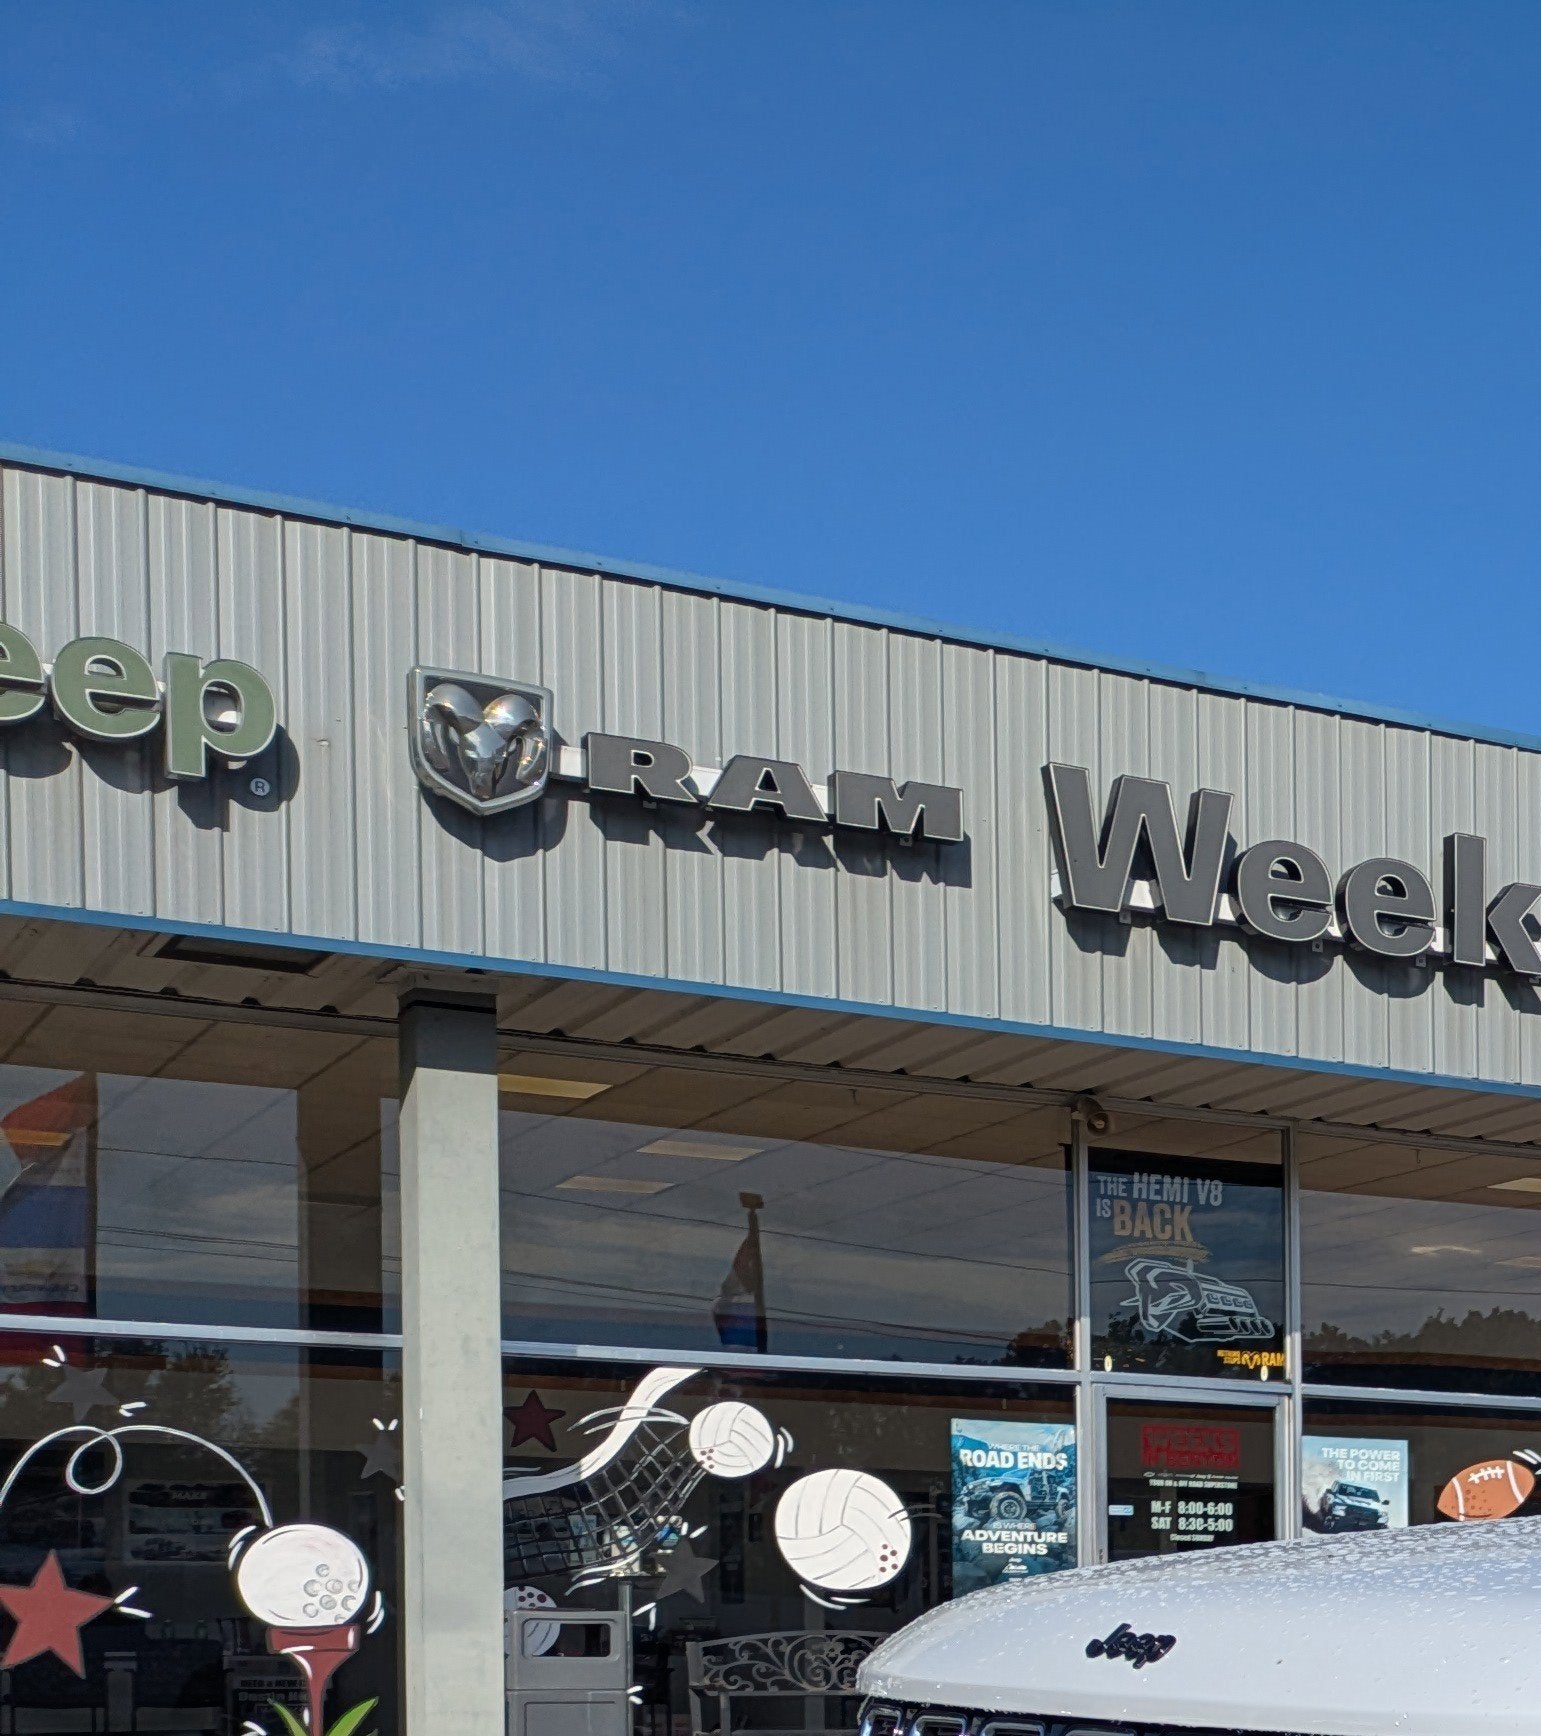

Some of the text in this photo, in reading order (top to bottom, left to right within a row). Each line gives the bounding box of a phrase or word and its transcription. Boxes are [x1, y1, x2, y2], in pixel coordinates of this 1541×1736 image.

[585, 731, 964, 842] RAM
[1094, 1172, 1224, 1207] THE HEMI V8
[1096, 1198, 1194, 1242] IS BACK
[960, 1449, 1068, 1471] ROAD ENDS
[1321, 1447, 1400, 1461] THE POWER
[1337, 1459, 1400, 1471] TO COME
[1346, 1471, 1400, 1482] IN FIRST
[1151, 1500, 1233, 1516] M-F 8:00-6:00
[1151, 1516, 1172, 1529] SAT
[961, 1530, 1068, 1544] ADVENTURE
[981, 1543, 1048, 1555] BEGINS
[1085, 1622, 1177, 1670] Jeep
